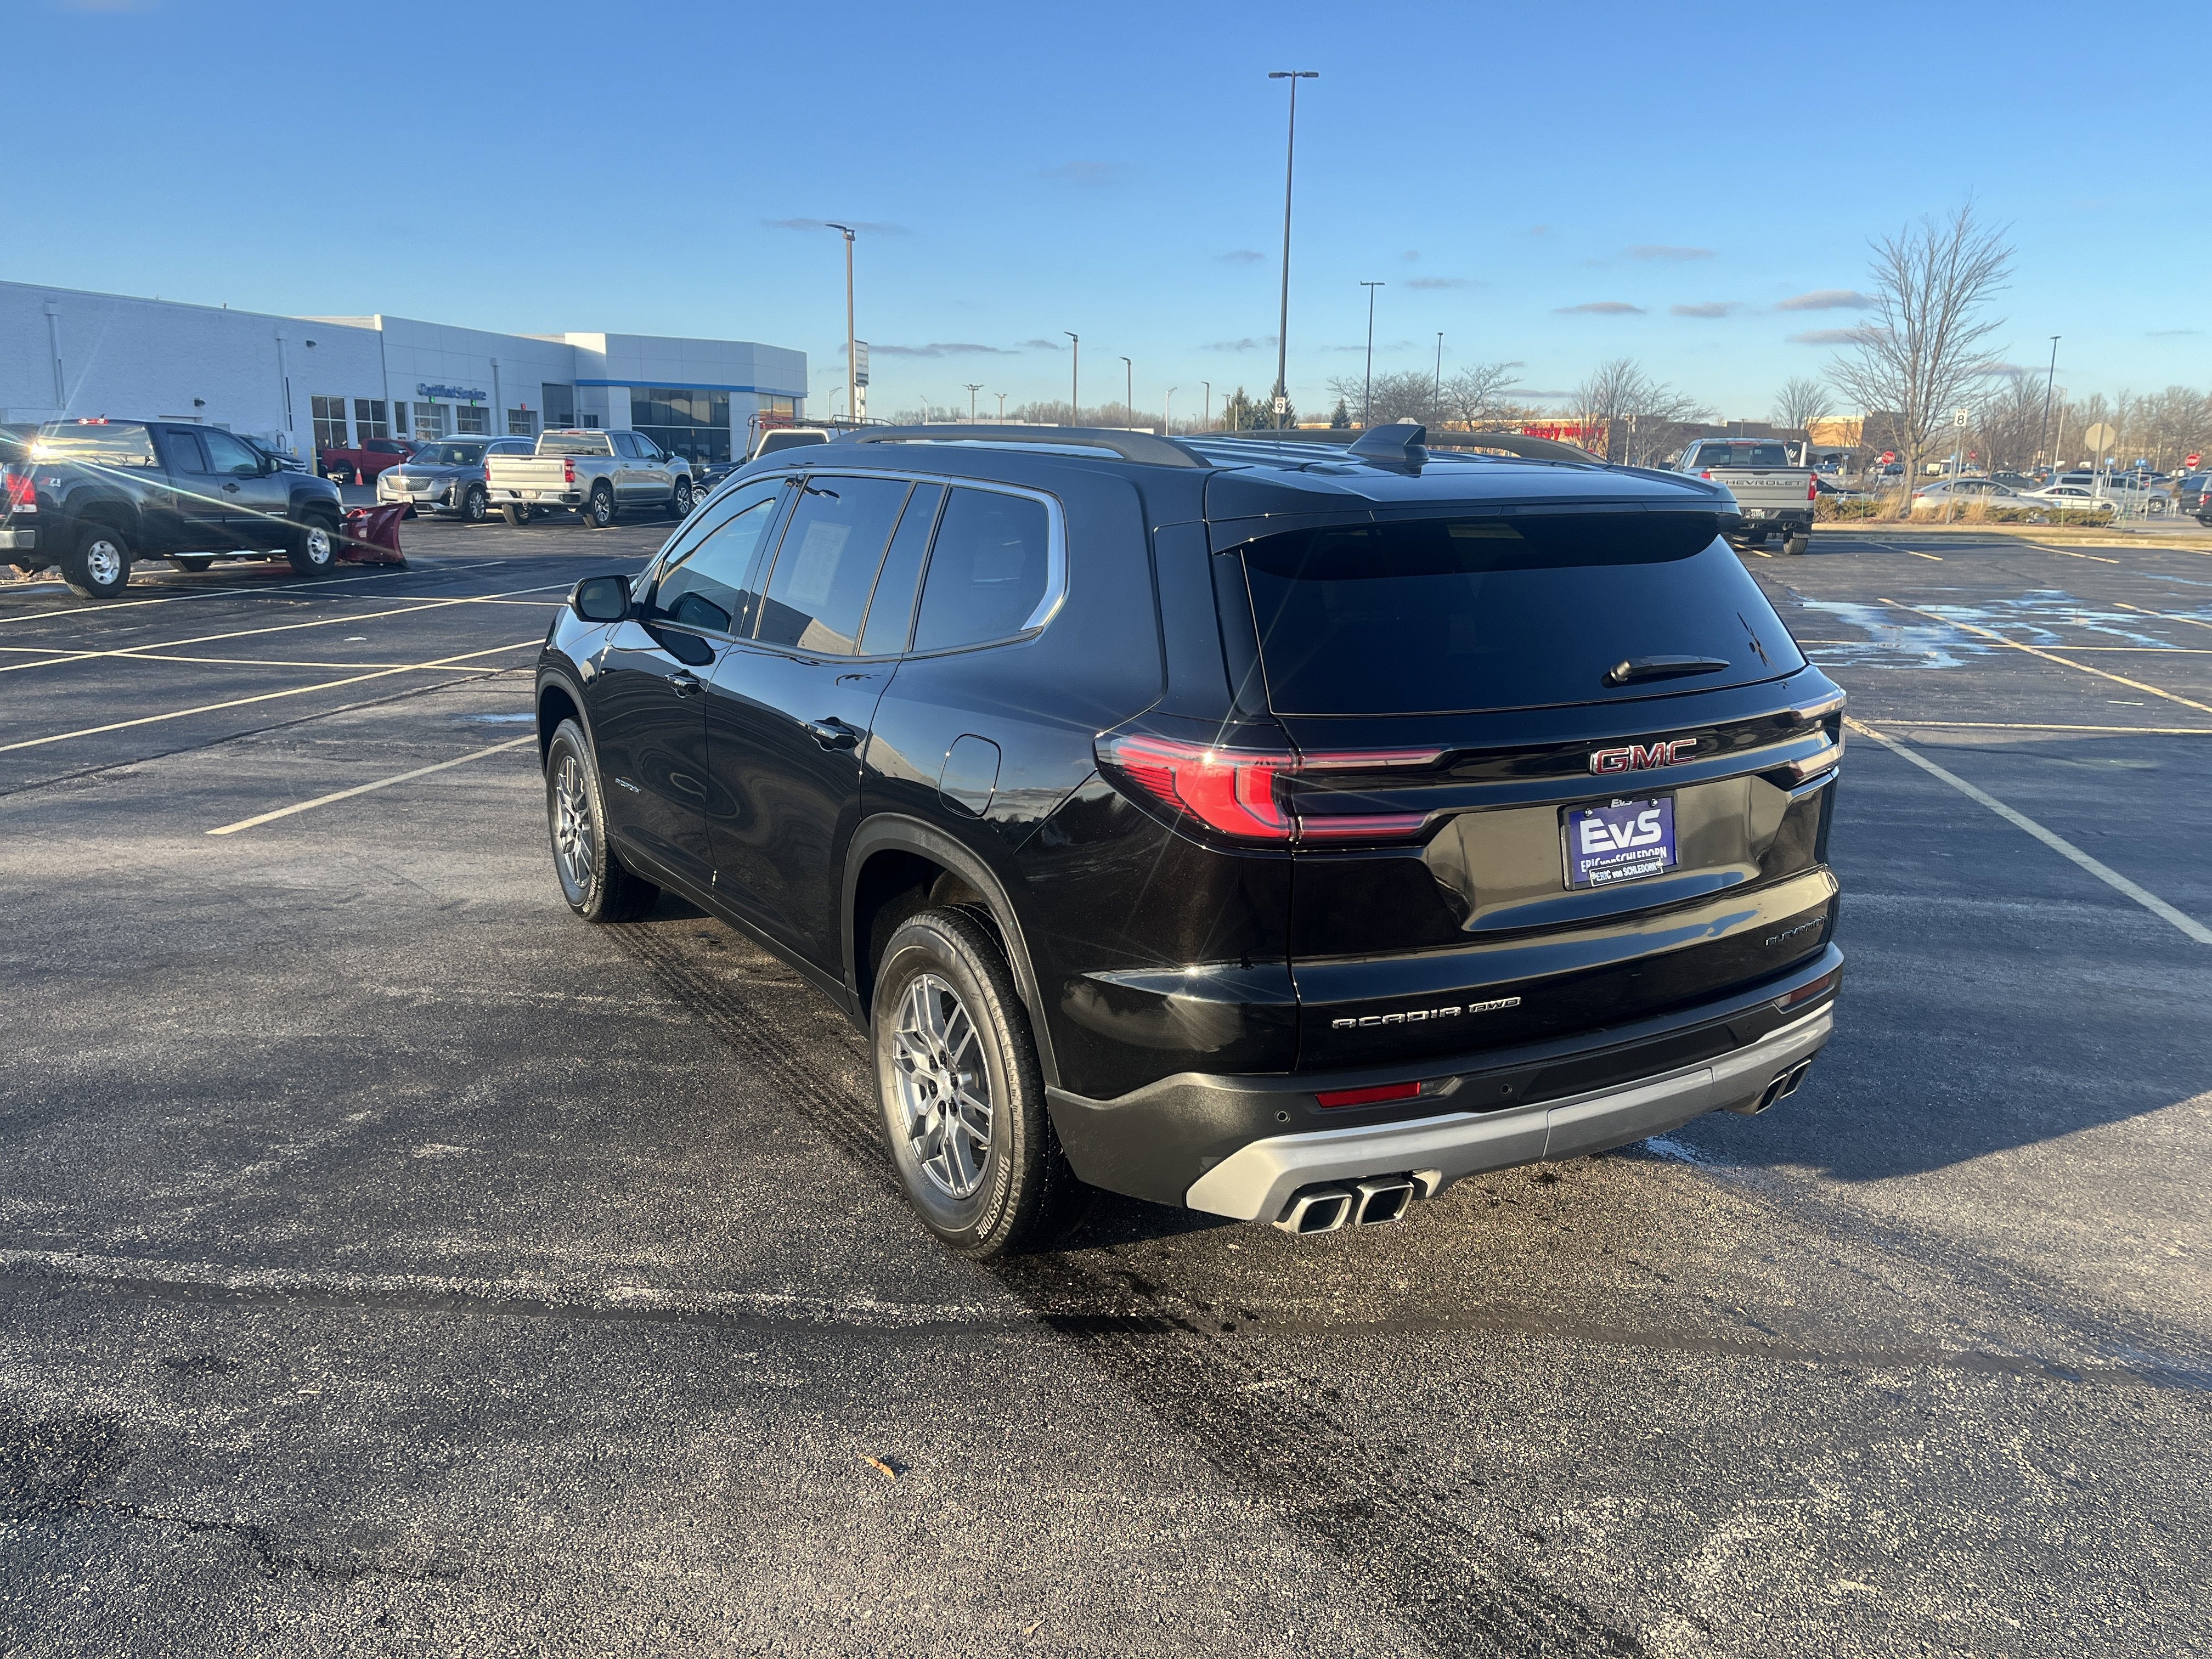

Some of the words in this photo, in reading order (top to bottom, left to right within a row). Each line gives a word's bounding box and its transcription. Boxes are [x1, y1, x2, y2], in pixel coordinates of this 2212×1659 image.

[1277, 403, 1283, 412] 9
[1957, 415, 1964, 425] 8
[1590, 738, 1697, 775] GMC
[1580, 809, 1662, 854] EvS
[1597, 871, 1611, 881] ERIC
[1623, 862, 1657, 877] SCHLEDORN
[1332, 1007, 1462, 1029] ACADIA
[1469, 997, 1521, 1013] AWD
[975, 1152, 1011, 1239] BRIDGESTONE
